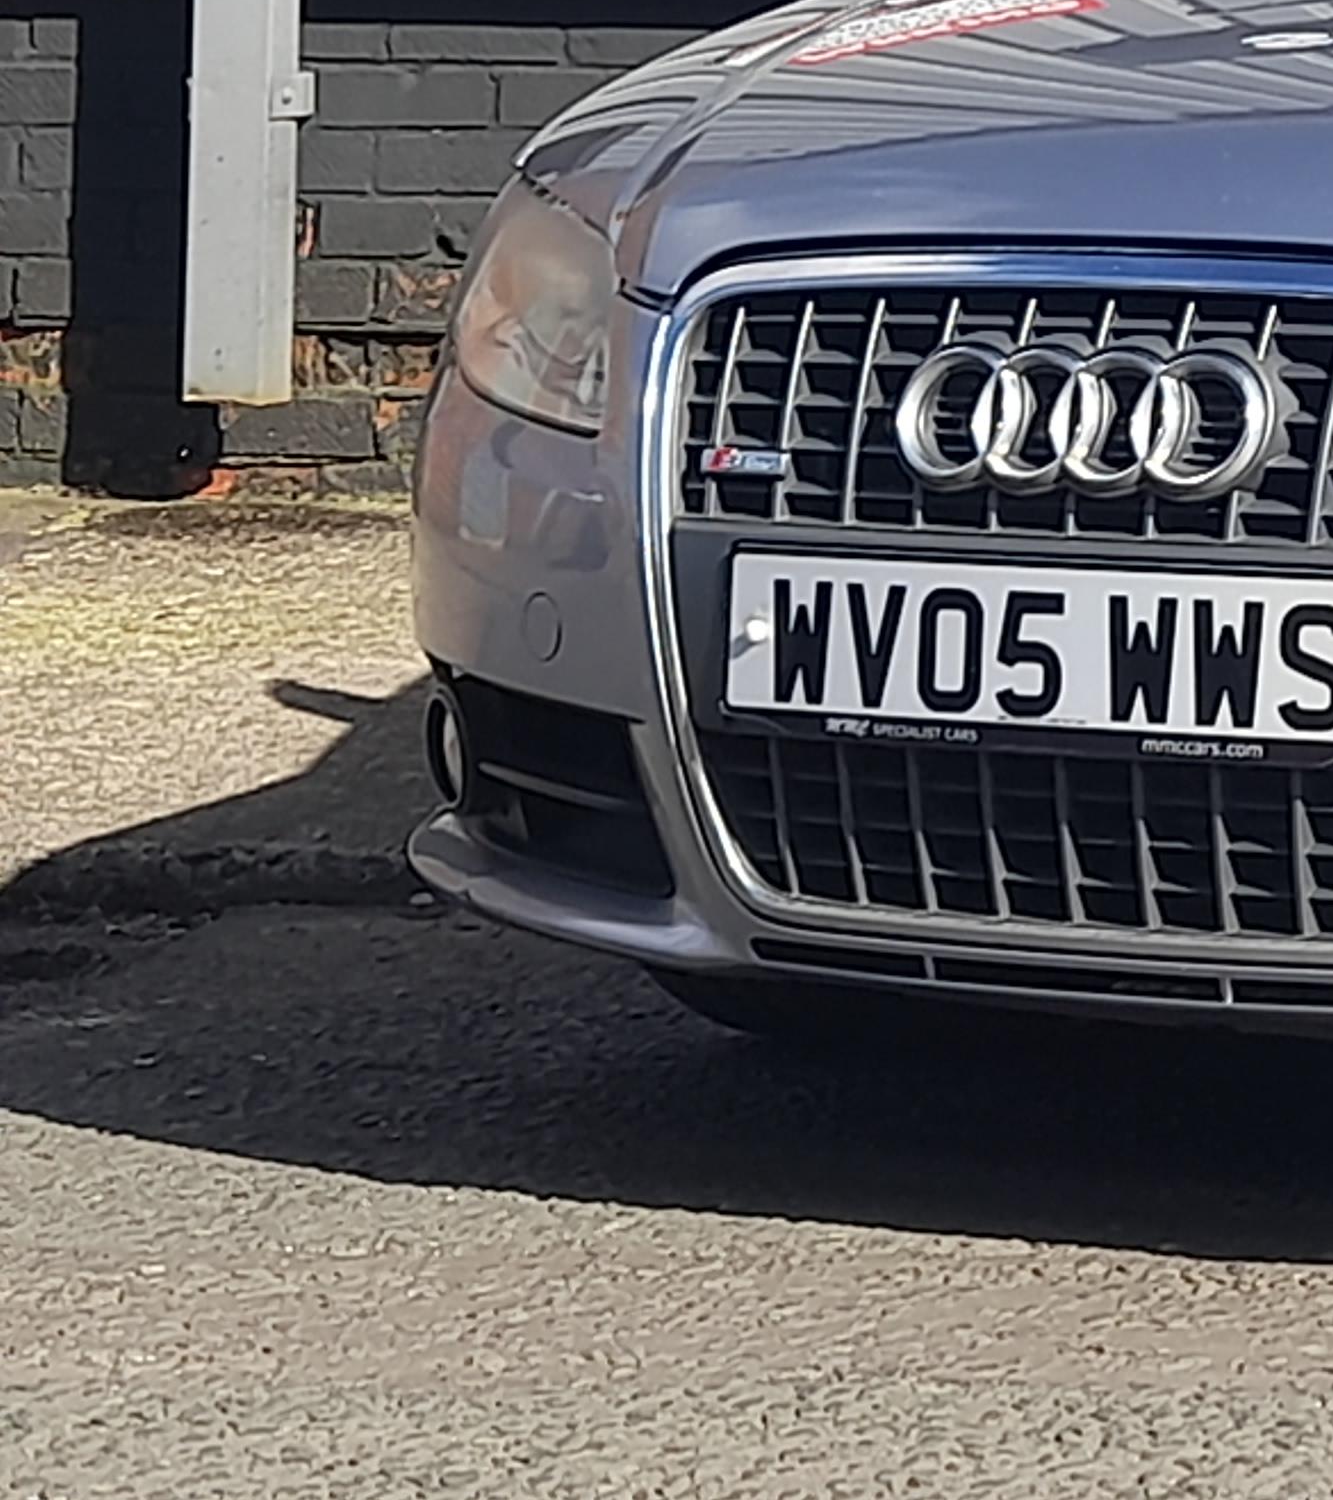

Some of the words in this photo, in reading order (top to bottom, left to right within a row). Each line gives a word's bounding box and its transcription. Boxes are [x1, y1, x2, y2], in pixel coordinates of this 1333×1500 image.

[772, 579, 1064, 718] WV05
[872, 722, 941, 740] SPECIALIST
[943, 727, 978, 742] CARS
[1140, 738, 1265, 758] mmccars.com
